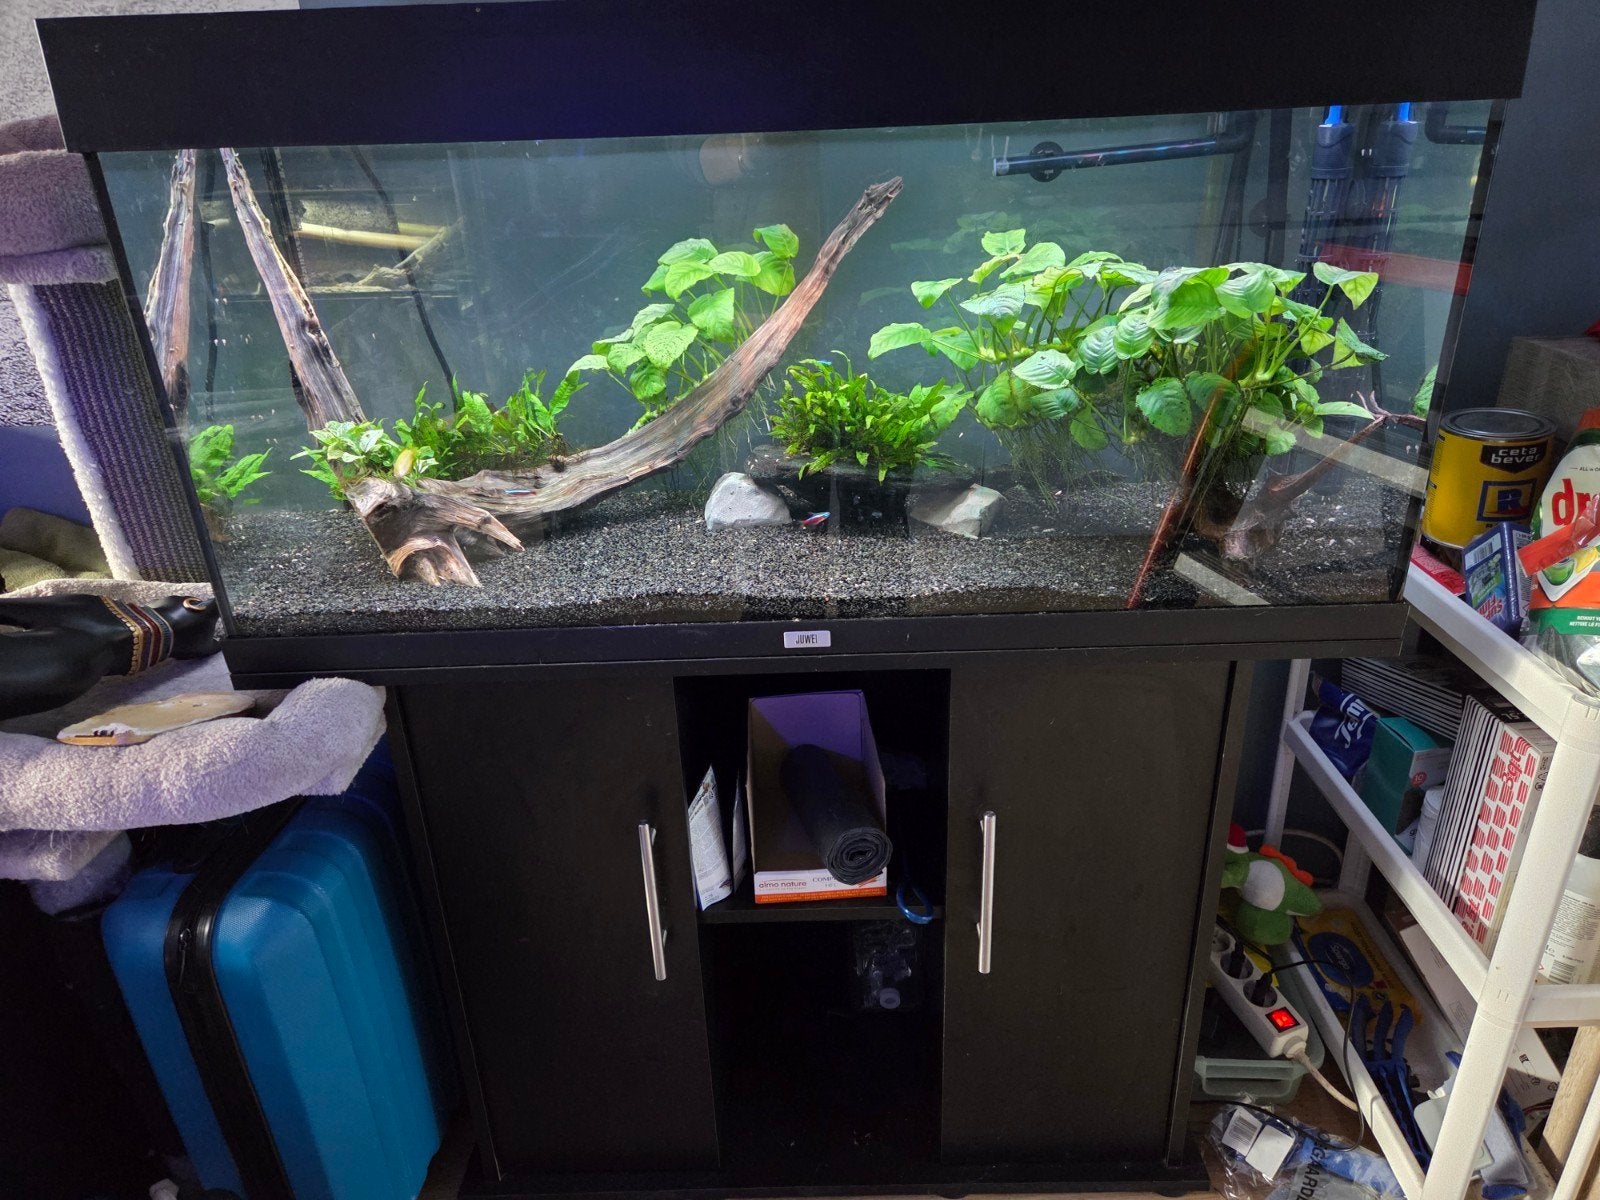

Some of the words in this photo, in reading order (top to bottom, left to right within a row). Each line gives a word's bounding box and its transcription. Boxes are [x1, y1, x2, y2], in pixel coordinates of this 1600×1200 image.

[1498, 447, 1537, 456] ceta
[1491, 454, 1540, 464] bever
[1551, 478, 1591, 526] dr
[780, 880, 807, 888] nature
